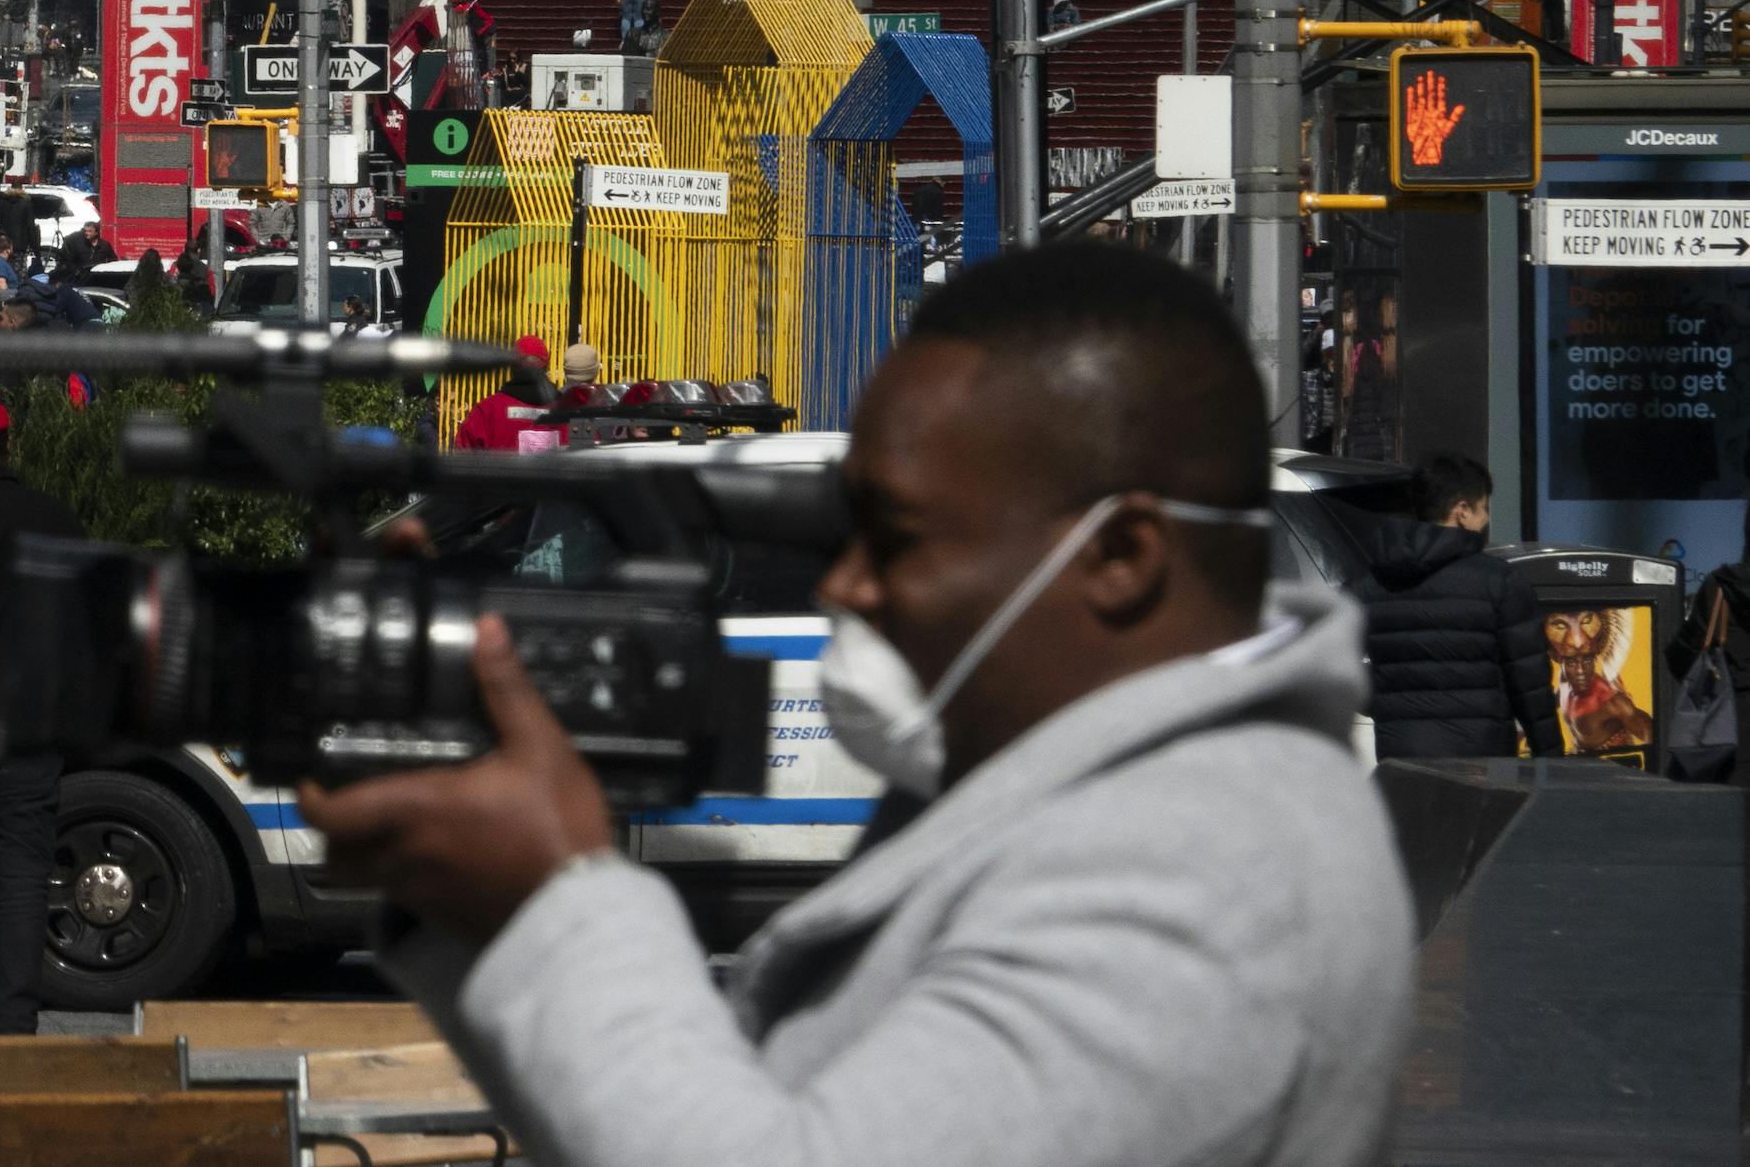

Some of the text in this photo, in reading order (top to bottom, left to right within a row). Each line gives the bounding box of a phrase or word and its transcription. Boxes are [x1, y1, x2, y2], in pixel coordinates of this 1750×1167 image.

[873, 15, 937, 34] W 45 St
[268, 61, 298, 78] ON
[1625, 129, 1719, 146] JCDecaux
[431, 170, 456, 179] FREE
[603, 171, 723, 190] PEDESTRIAN FLOW ZONE
[1187, 184, 1208, 197] FLOW
[1210, 183, 1232, 195] ZONE
[656, 194, 722, 208] KEEP MOVING
[1136, 200, 1189, 212] KEEP MOVING
[1563, 209, 1750, 230] PEDESTRIAN FLOW ZONE
[1562, 236, 1666, 256] KEEP MOVING
[1666, 313, 1706, 334] for
[1567, 341, 1732, 369] empowering
[1567, 370, 1728, 398] doers to get
[1567, 398, 1718, 419] more done.
[1558, 562, 1610, 573] BigBelly
